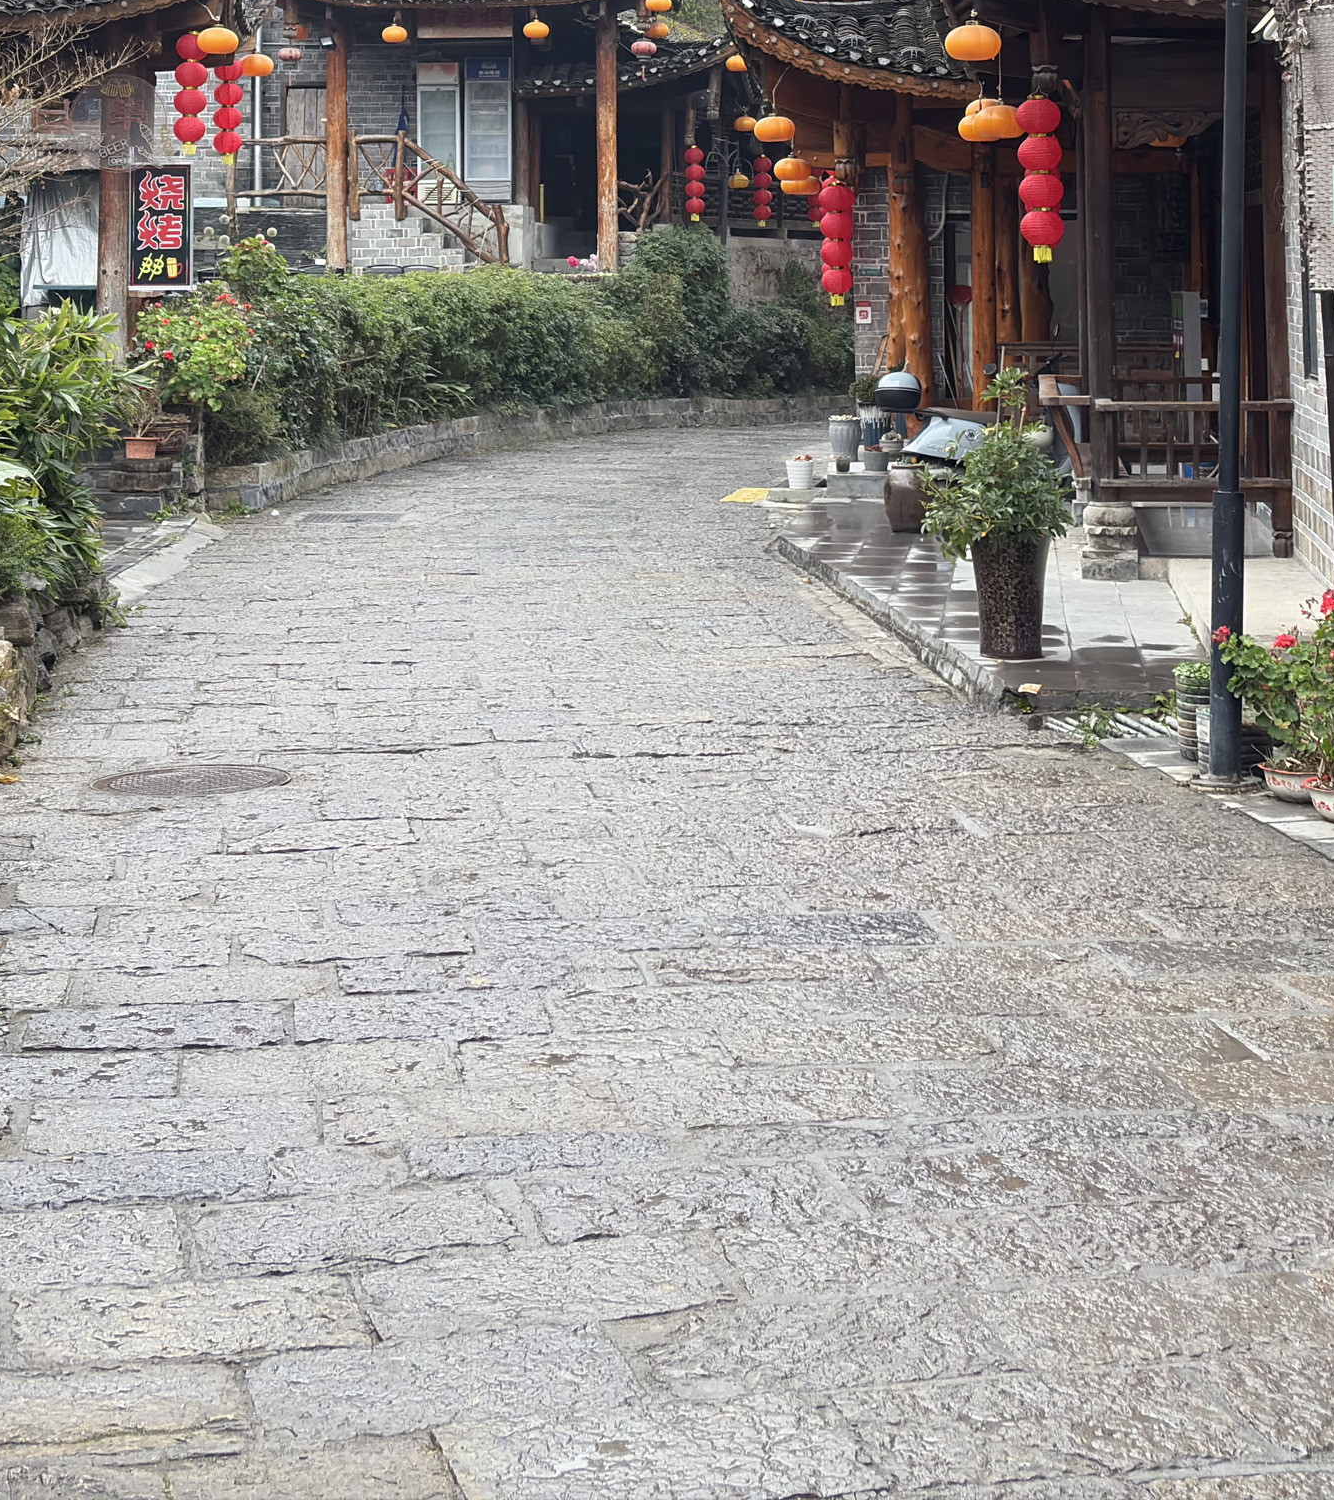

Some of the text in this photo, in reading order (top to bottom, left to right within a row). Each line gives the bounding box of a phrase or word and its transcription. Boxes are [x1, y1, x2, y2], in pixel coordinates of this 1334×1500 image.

[109, 97, 149, 131] 串
[98, 138, 129, 159] BEER
[136, 170, 185, 251] 烧烤
